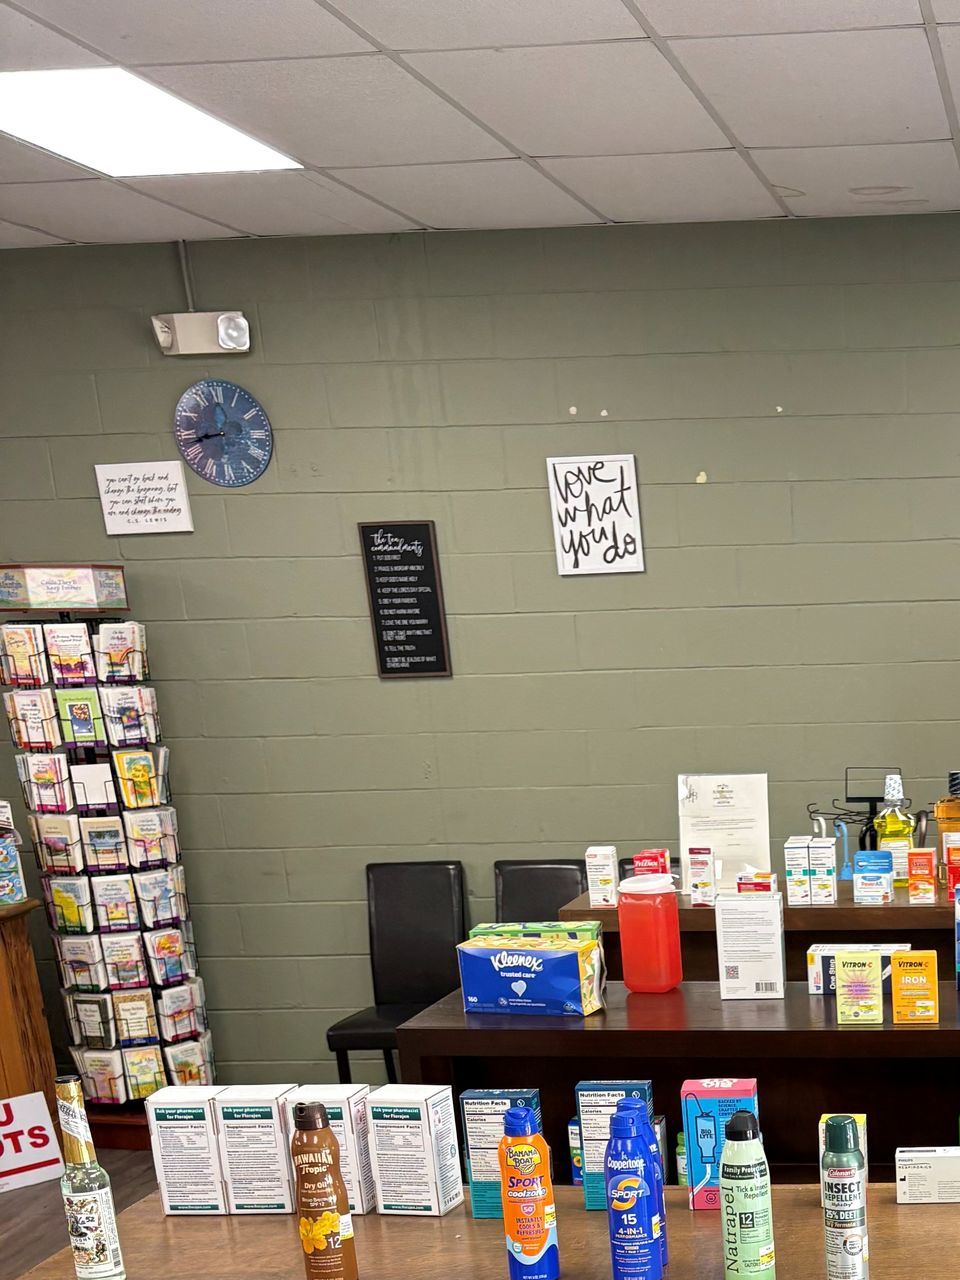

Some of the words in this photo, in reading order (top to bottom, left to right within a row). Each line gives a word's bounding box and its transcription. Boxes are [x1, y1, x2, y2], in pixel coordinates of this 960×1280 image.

[558, 466, 632, 527] what
[561, 526, 608, 568] you
[604, 521, 636, 563] do
[490, 951, 544, 972] Kleenex
[902, 976, 926, 984] IRON
[509, 1176, 544, 1188] SPORT
[824, 1181, 861, 1192] INSECT
[611, 1189, 644, 1199] SPORT
[621, 1214, 637, 1224] 15
[741, 1214, 752, 1223] 12
[826, 1210, 838, 1220] 25%
[840, 1210, 857, 1220] DEET
[722, 1186, 739, 1273] Natrapel
[328, 1236, 342, 1249] 12
